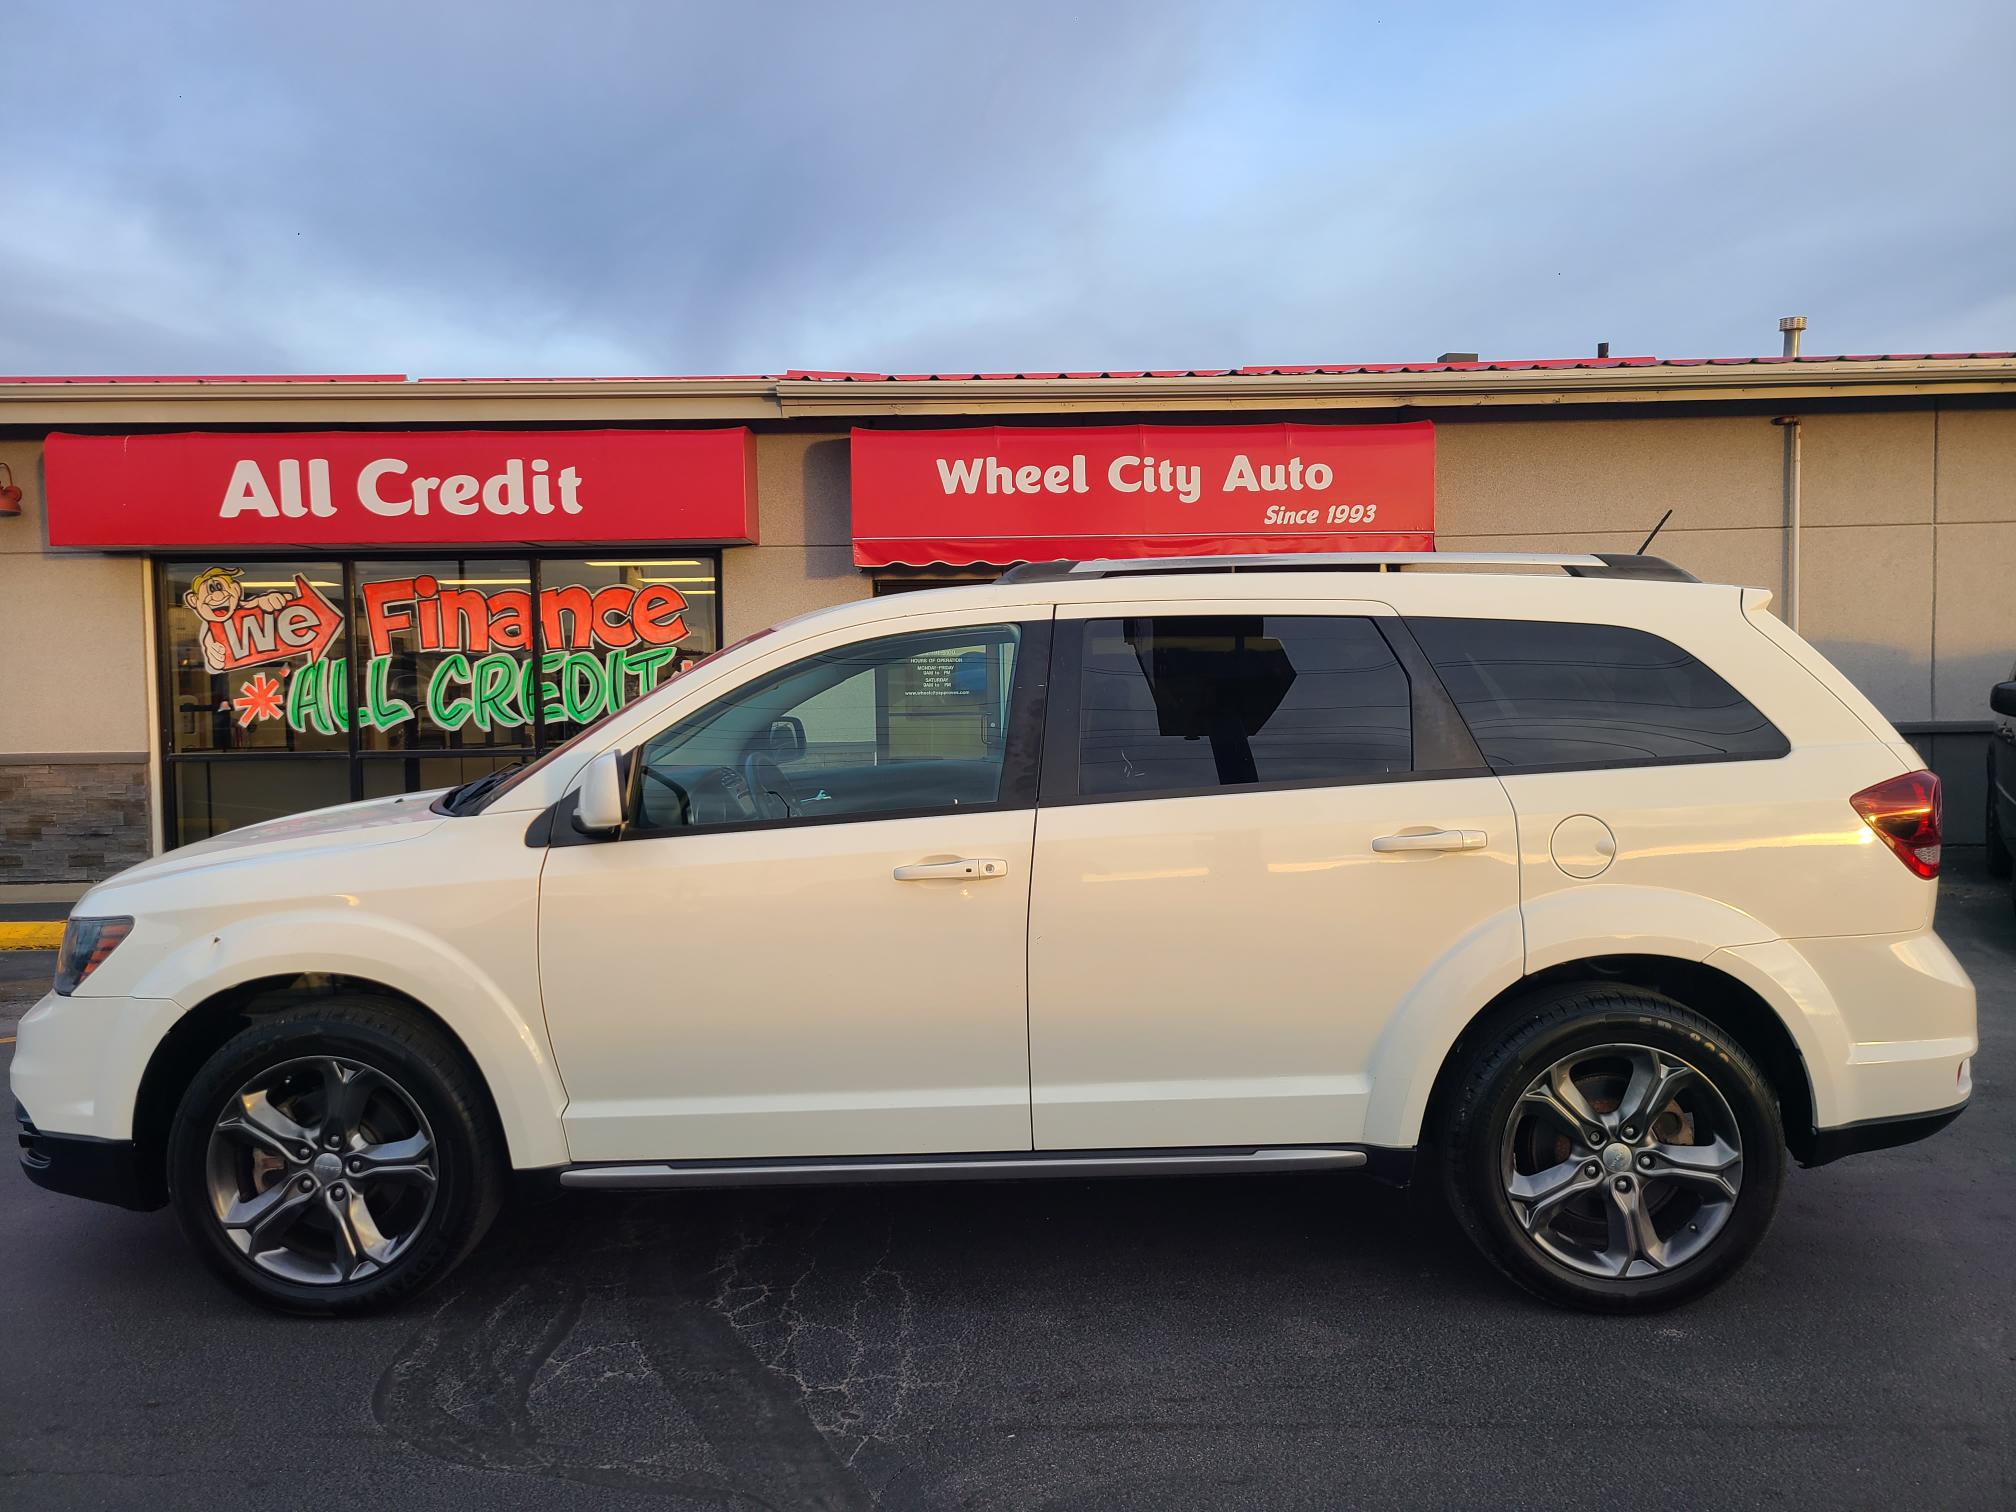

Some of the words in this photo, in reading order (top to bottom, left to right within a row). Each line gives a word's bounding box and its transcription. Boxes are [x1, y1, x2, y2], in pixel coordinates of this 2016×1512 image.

[220, 459, 338, 518] All
[357, 459, 584, 516] Credit
[936, 455, 1089, 494] Wheel
[1108, 456, 1201, 503] City
[1223, 455, 1334, 492] Auto
[1264, 505, 1320, 525] Since
[1327, 504, 1377, 524] 1993
[362, 574, 691, 659] Finance
[287, 655, 415, 736] ALL
[427, 647, 677, 732] CREDIT
